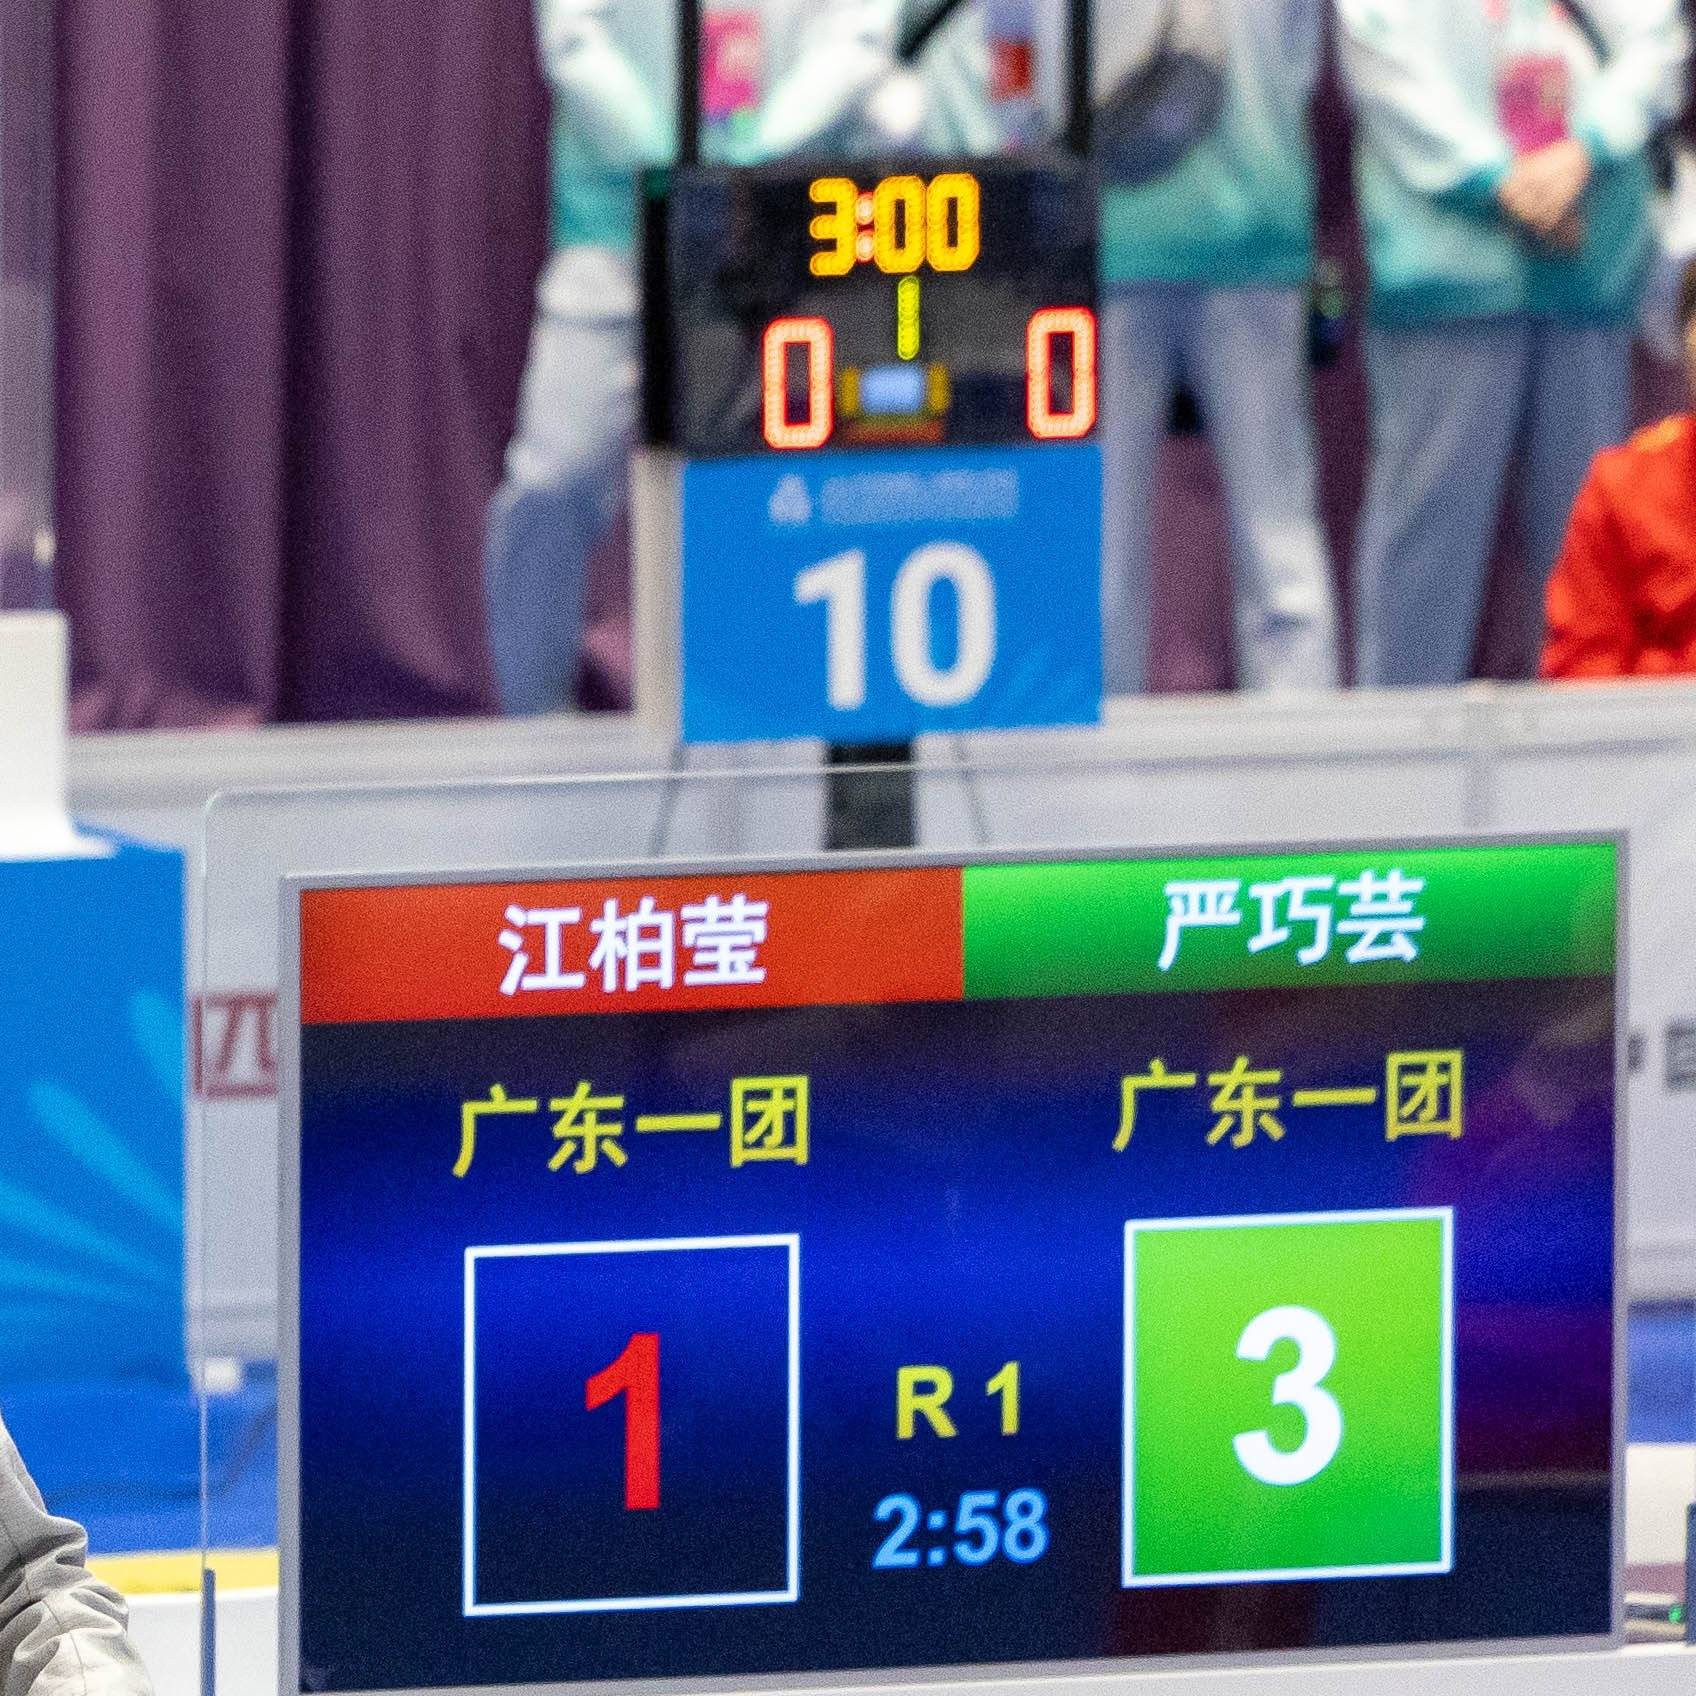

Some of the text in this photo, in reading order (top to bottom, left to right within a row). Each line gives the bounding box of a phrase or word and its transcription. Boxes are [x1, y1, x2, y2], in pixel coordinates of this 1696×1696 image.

[809, 172, 981, 277] 3:00
[763, 316, 834, 449] 0
[1026, 307, 1097, 439] 0
[794, 541, 997, 712] 10
[498, 893, 769, 995] 江柏莹
[1158, 869, 1426, 972] 严巧芸
[452, 1075, 809, 1178] 广东一团
[1112, 1048, 1464, 1152] 广东一团
[585, 1332, 661, 1511] 1
[896, 1361, 1021, 1440] R 1
[1232, 1305, 1344, 1487] 3
[873, 1488, 1049, 1569] 2:58
